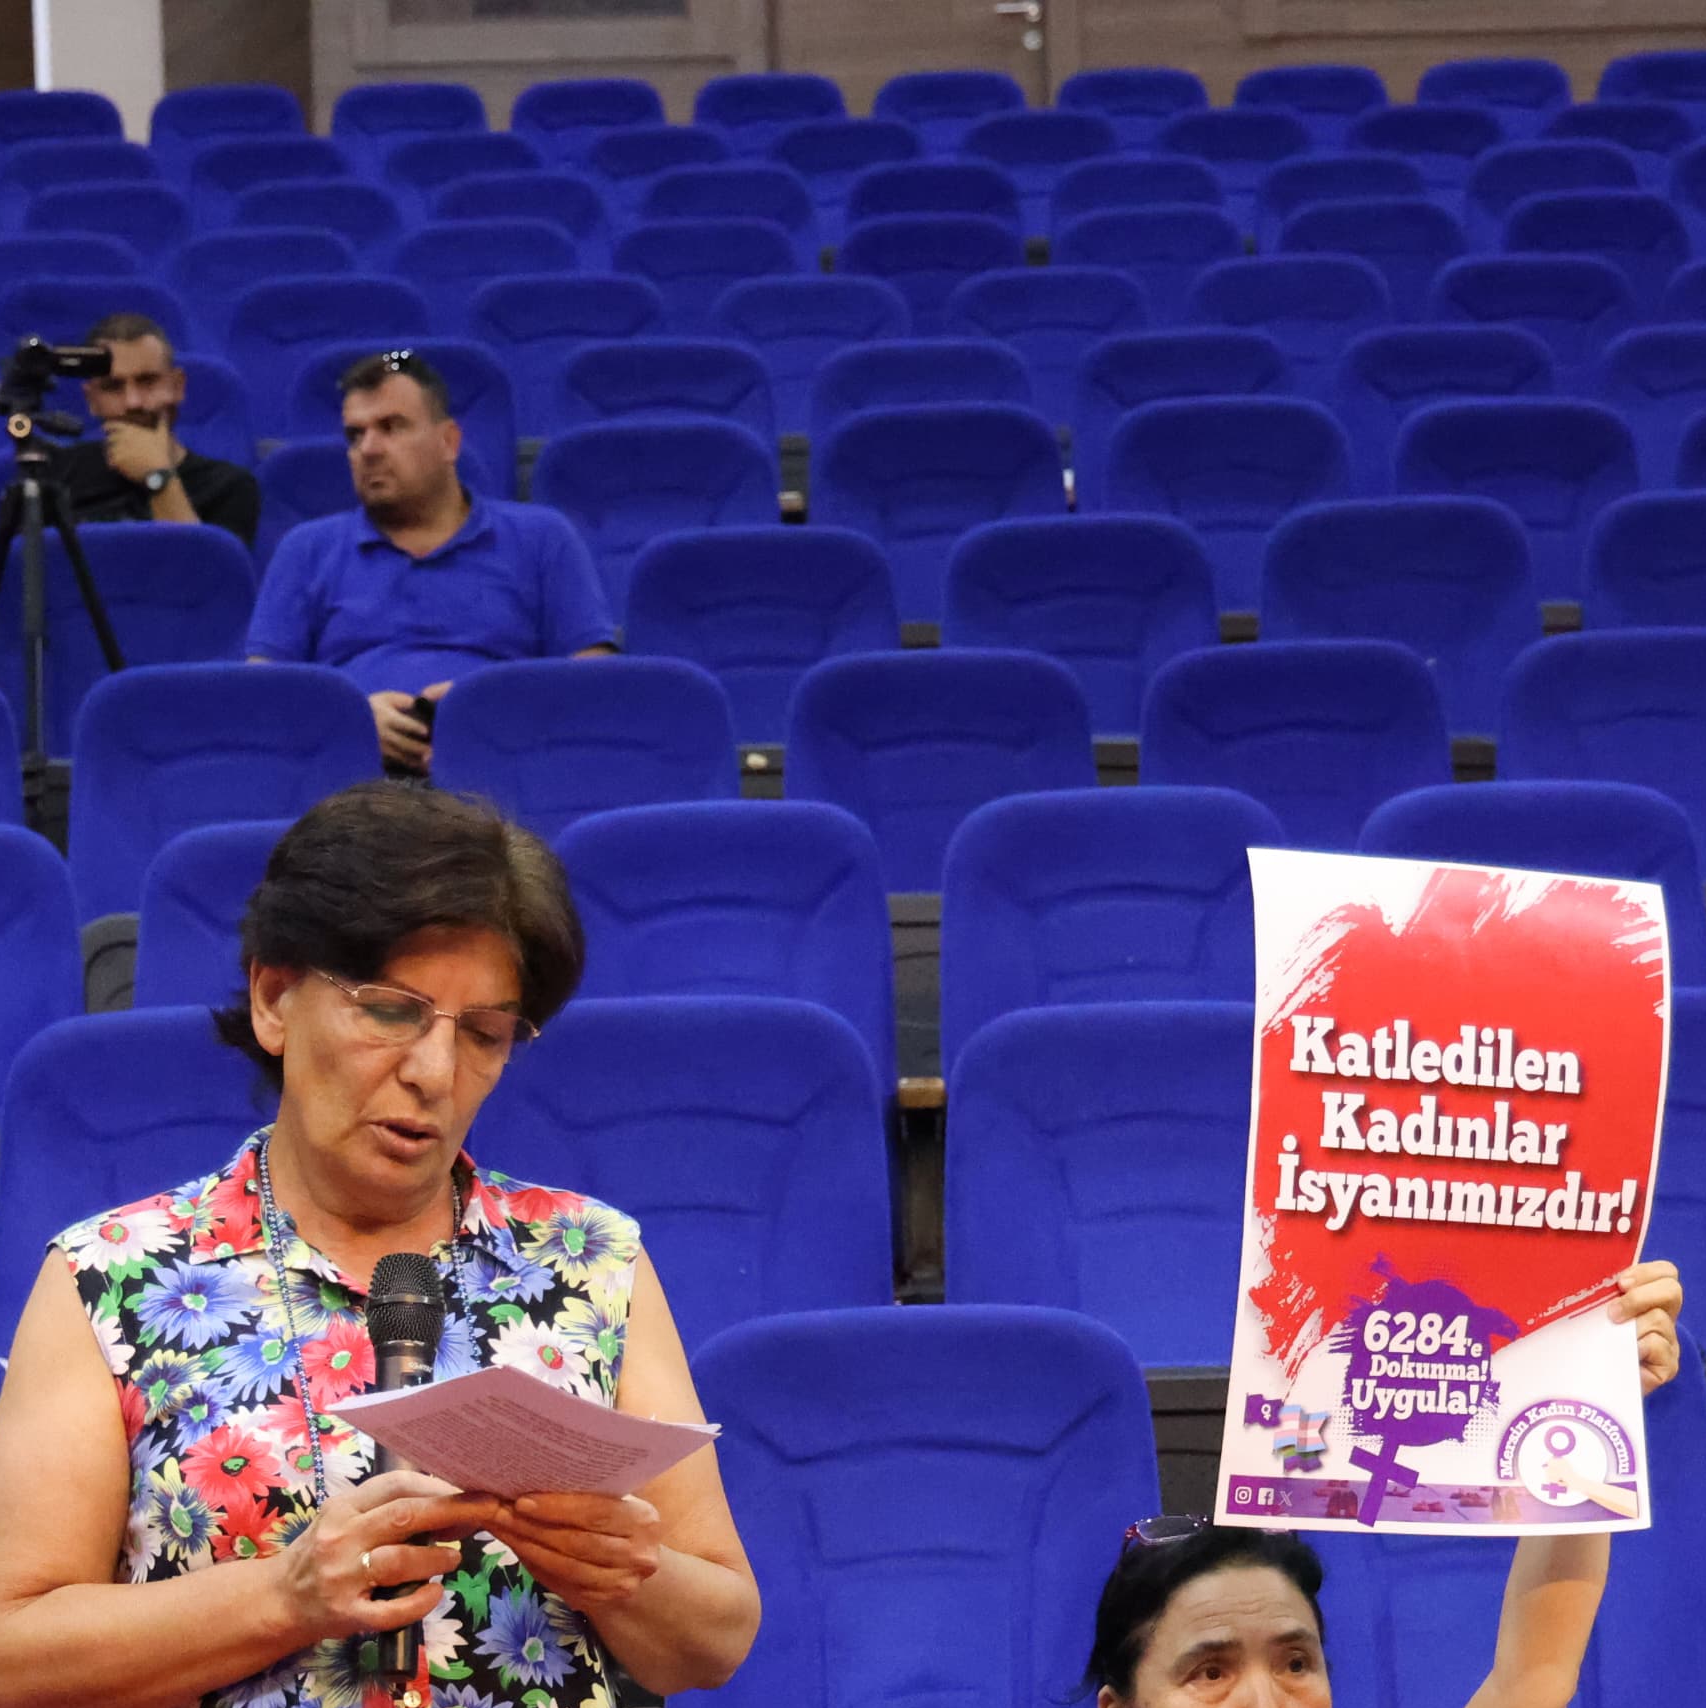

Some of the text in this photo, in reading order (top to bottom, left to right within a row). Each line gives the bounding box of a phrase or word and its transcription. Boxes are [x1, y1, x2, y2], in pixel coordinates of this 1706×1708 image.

[1289, 1014, 1581, 1095] Katledilen
[1319, 1091, 1567, 1165] Kadınlar
[1274, 1134, 1638, 1234] İsyanımızdır!
[1351, 1378, 1480, 1420] Uygula!
[1369, 1354, 1489, 1382] Dokunma!
[1499, 1402, 1630, 1479] Mersin Kadın Platformu
